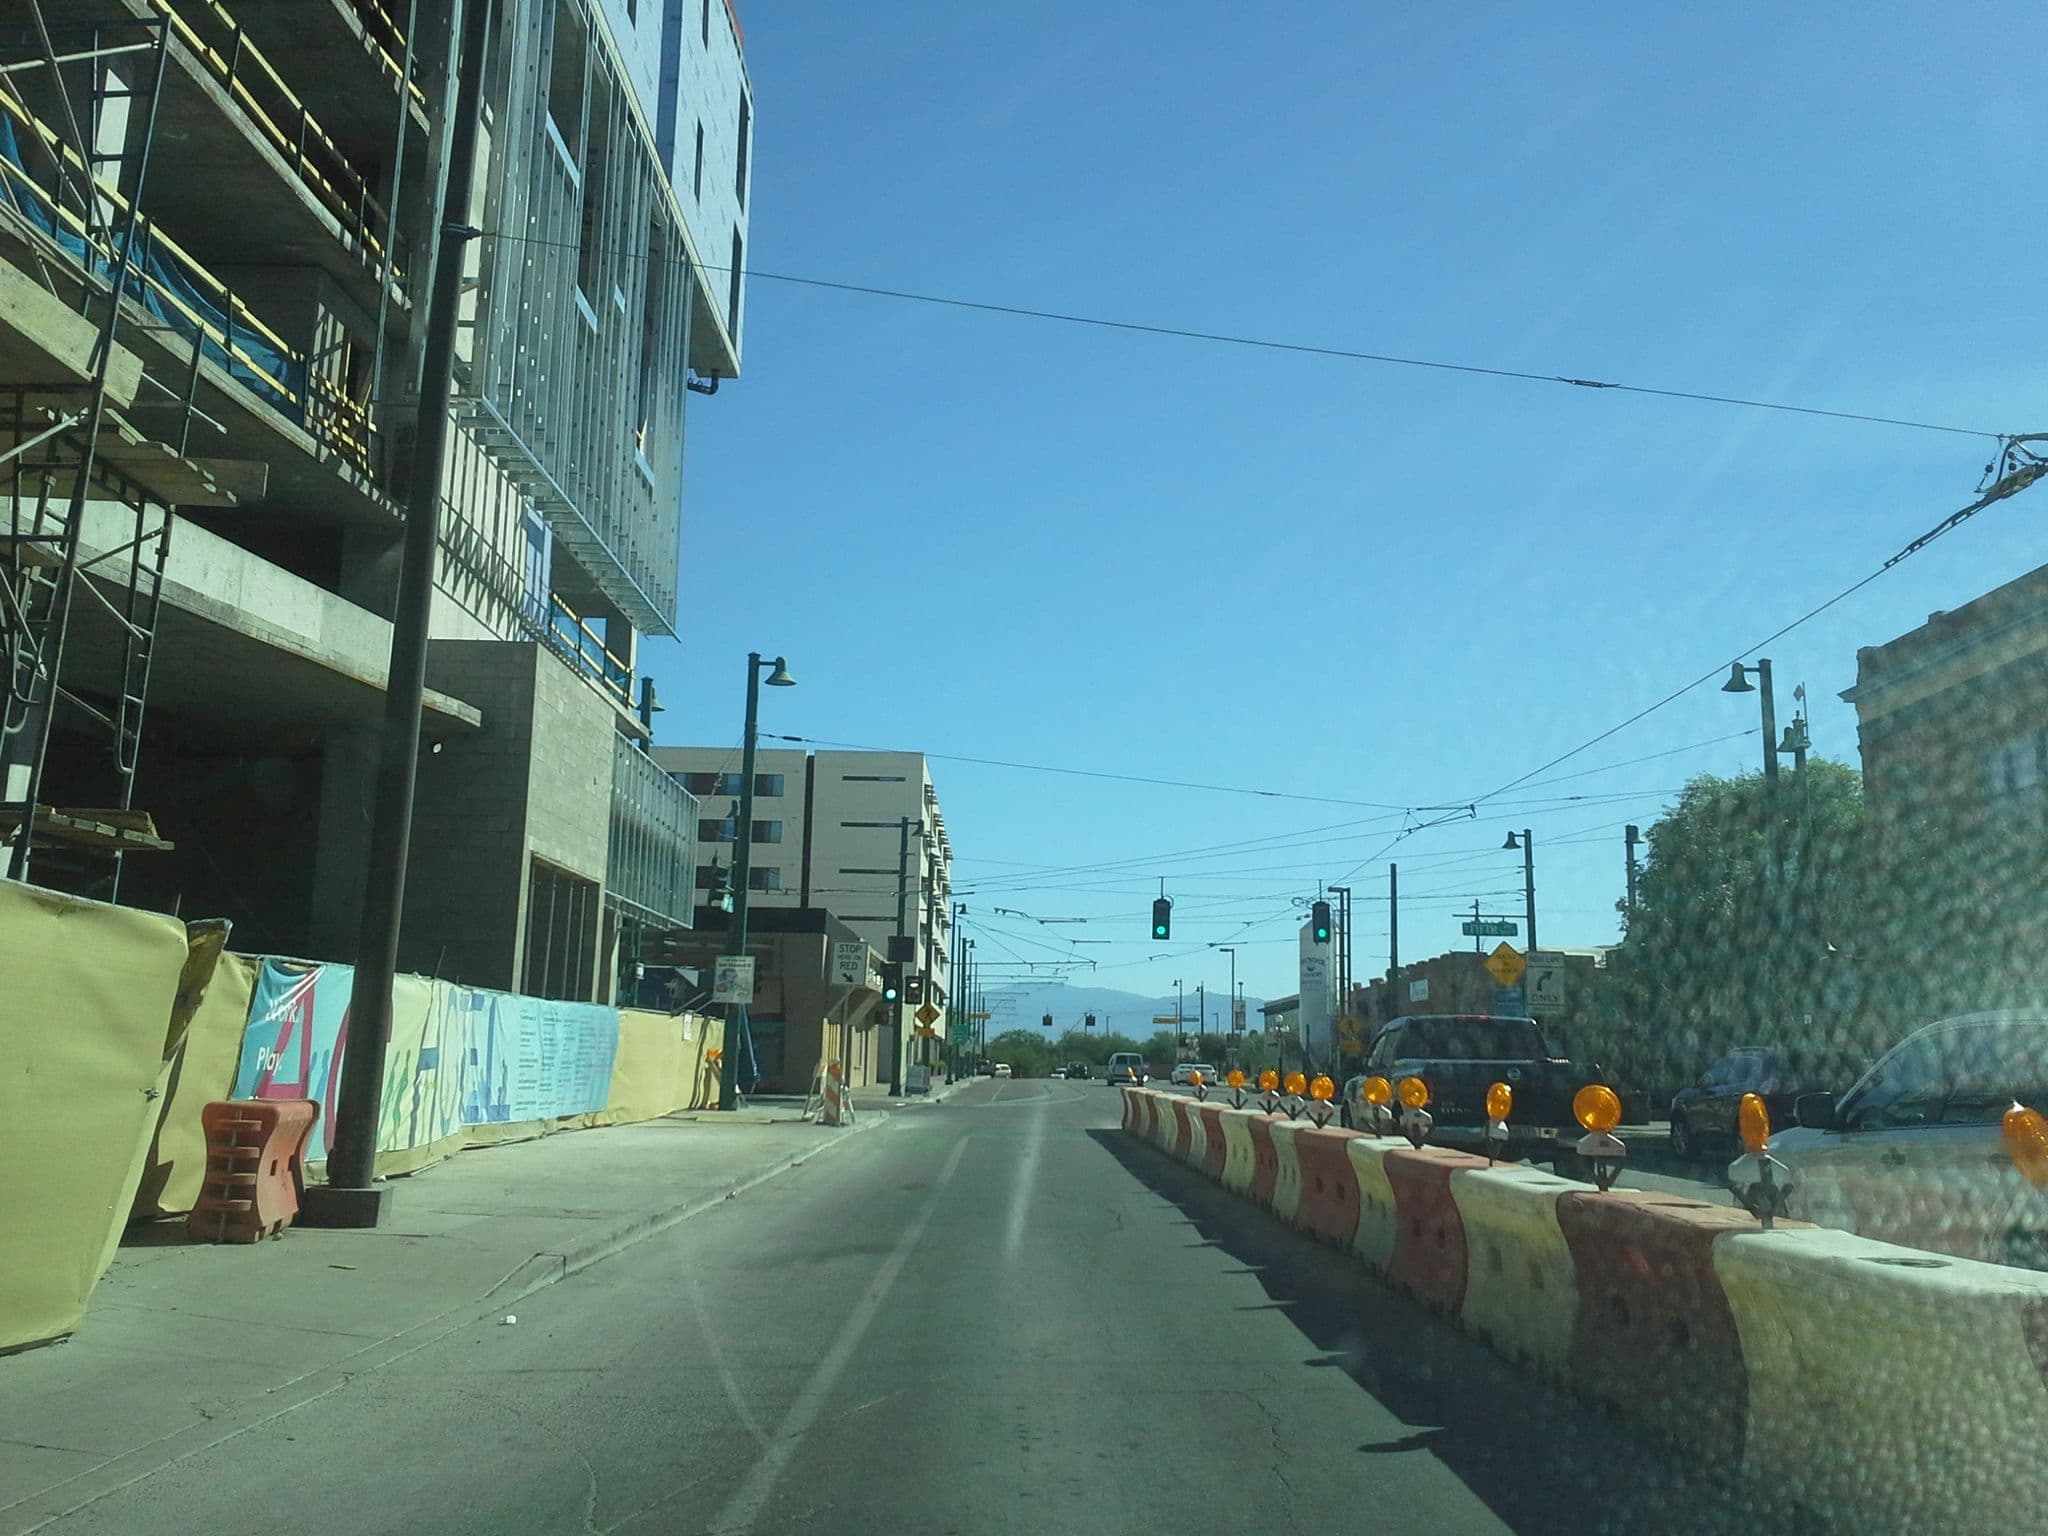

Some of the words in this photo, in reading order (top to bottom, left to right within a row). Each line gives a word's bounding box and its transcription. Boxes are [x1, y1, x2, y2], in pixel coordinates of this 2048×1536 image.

[839, 943, 862, 953] STOP
[839, 961, 858, 971] RED
[1531, 992, 1559, 1002] ONLY
[256, 1046, 282, 1076] Play.
